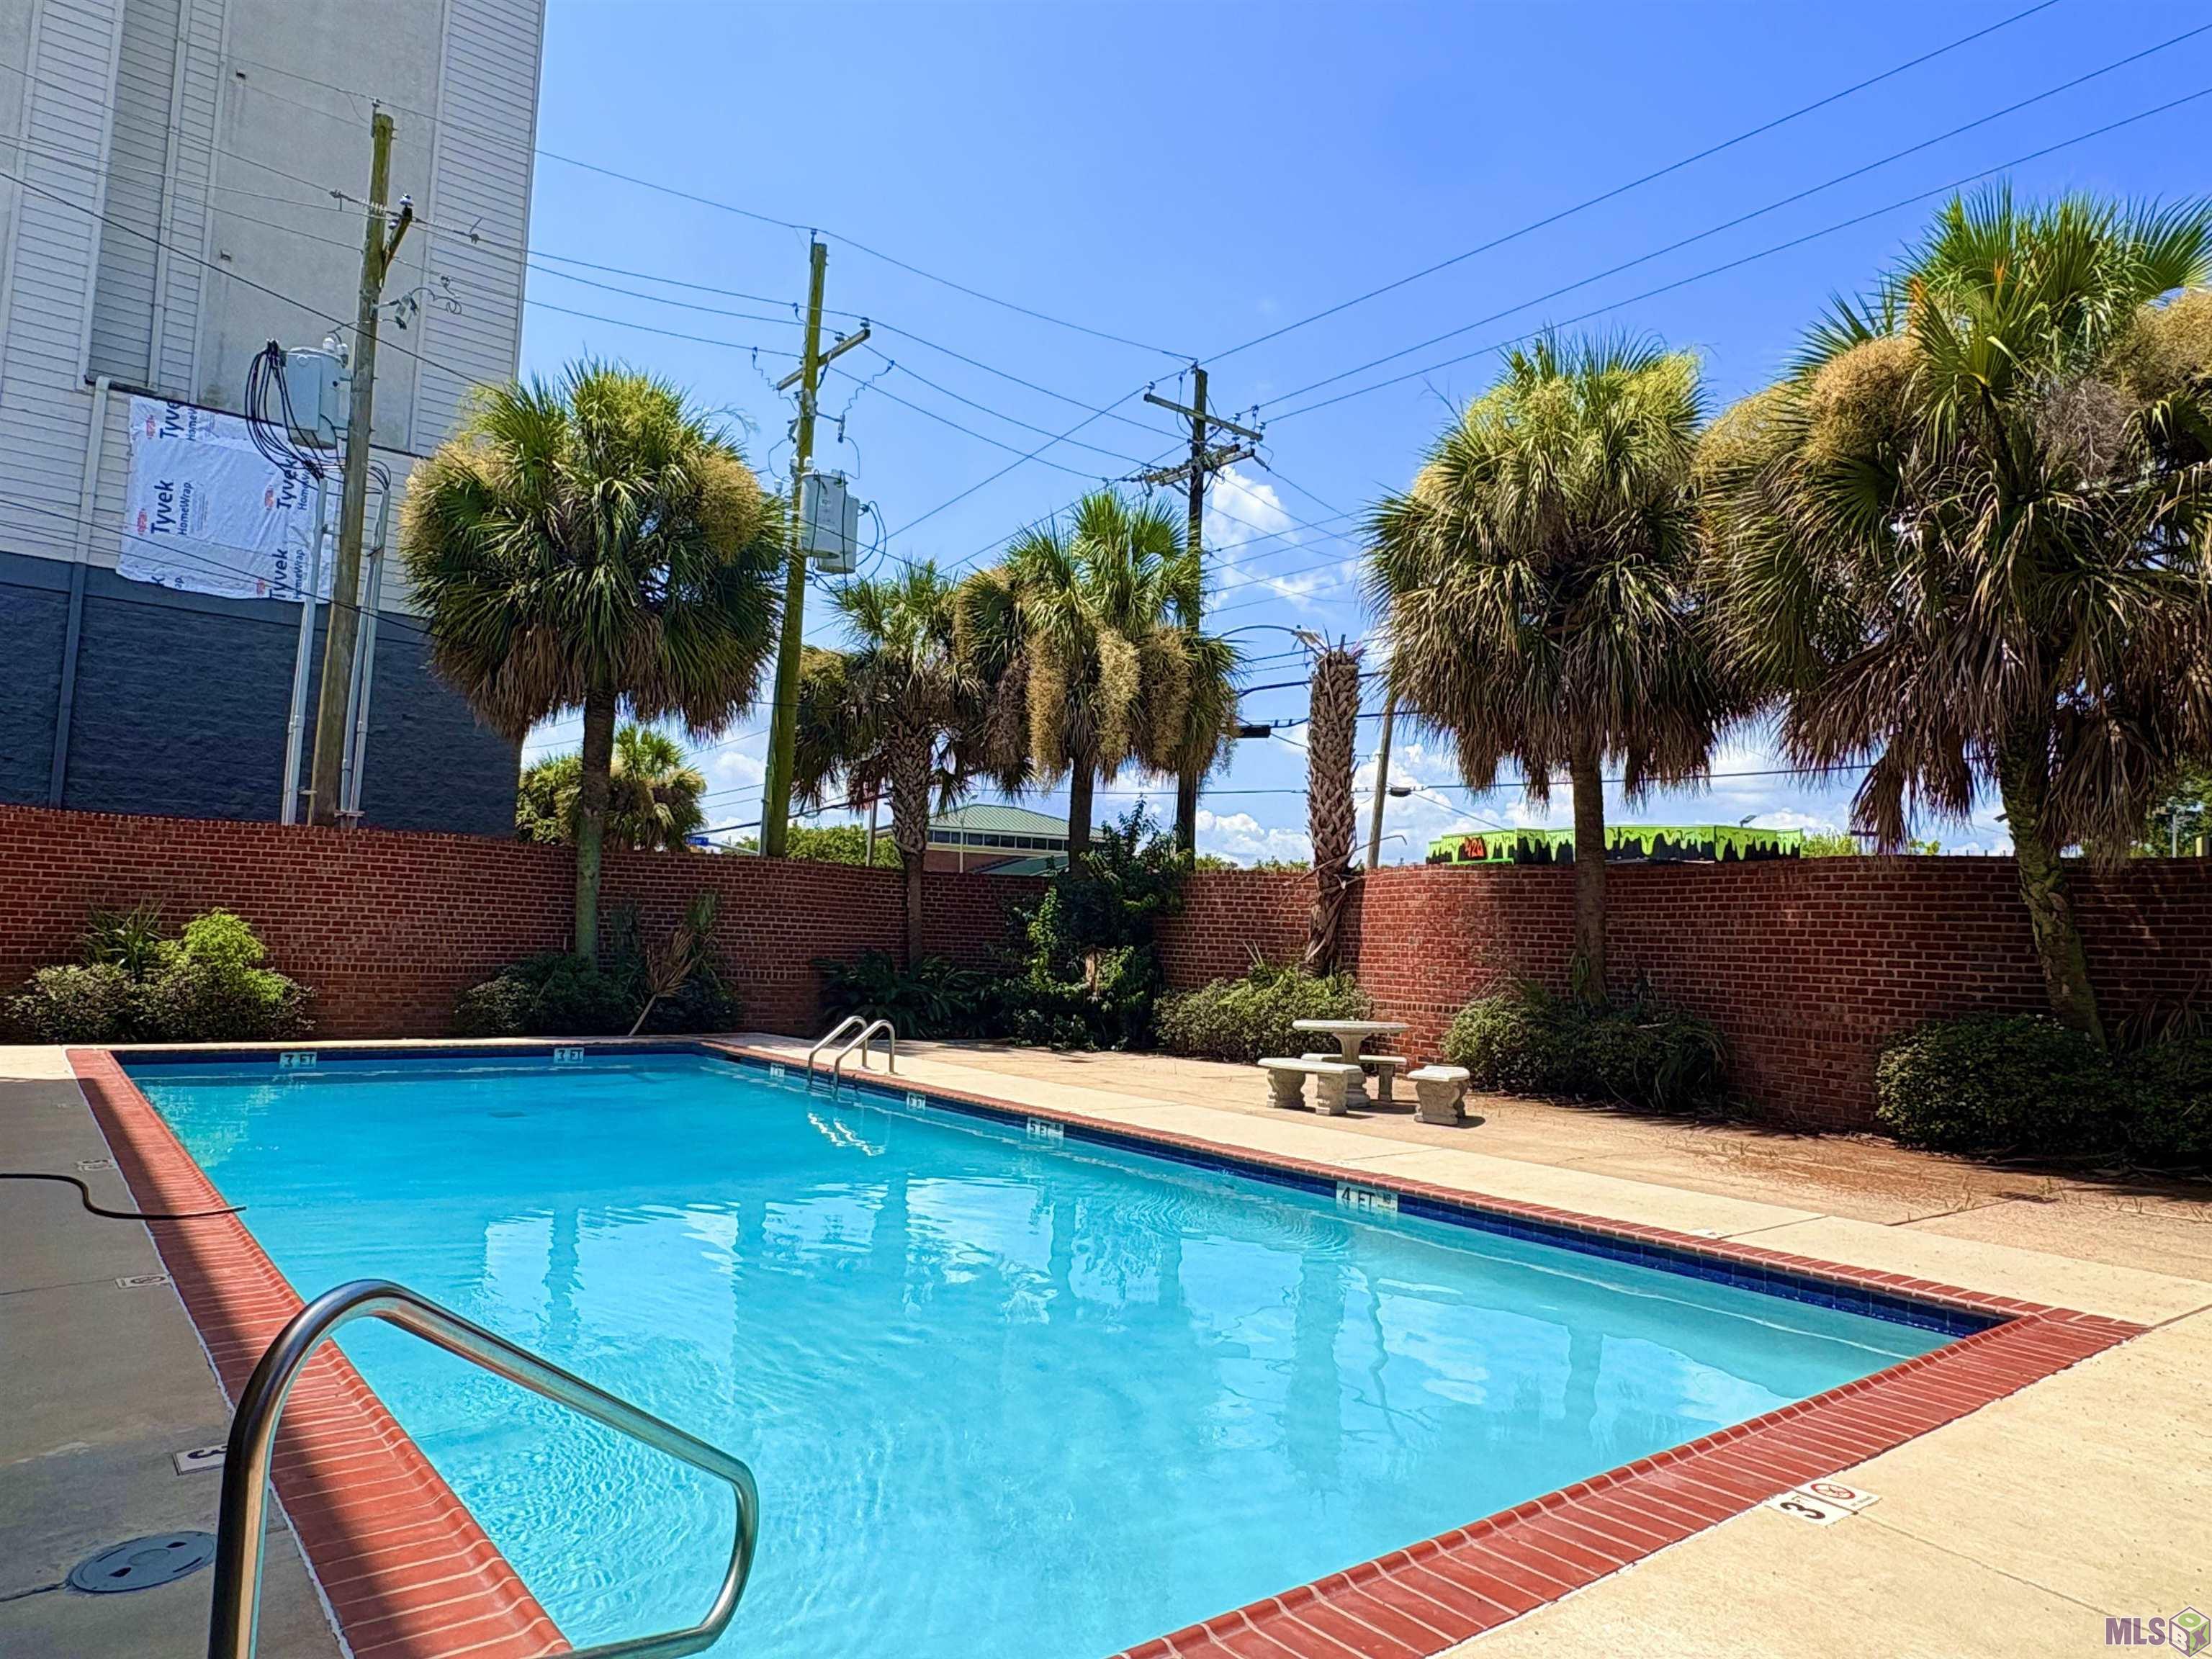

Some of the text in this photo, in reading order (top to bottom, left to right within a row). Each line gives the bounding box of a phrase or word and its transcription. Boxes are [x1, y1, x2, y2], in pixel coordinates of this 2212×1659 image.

[160, 401, 184, 439] Tyve
[150, 480, 176, 534] Tyvek
[177, 482, 194, 536] HomeWrap
[269, 549, 288, 598] Tyvek
[1341, 1187, 1351, 1201] 4
[1358, 1190, 1375, 1208] FT
[1780, 1502, 1825, 1519] 3
